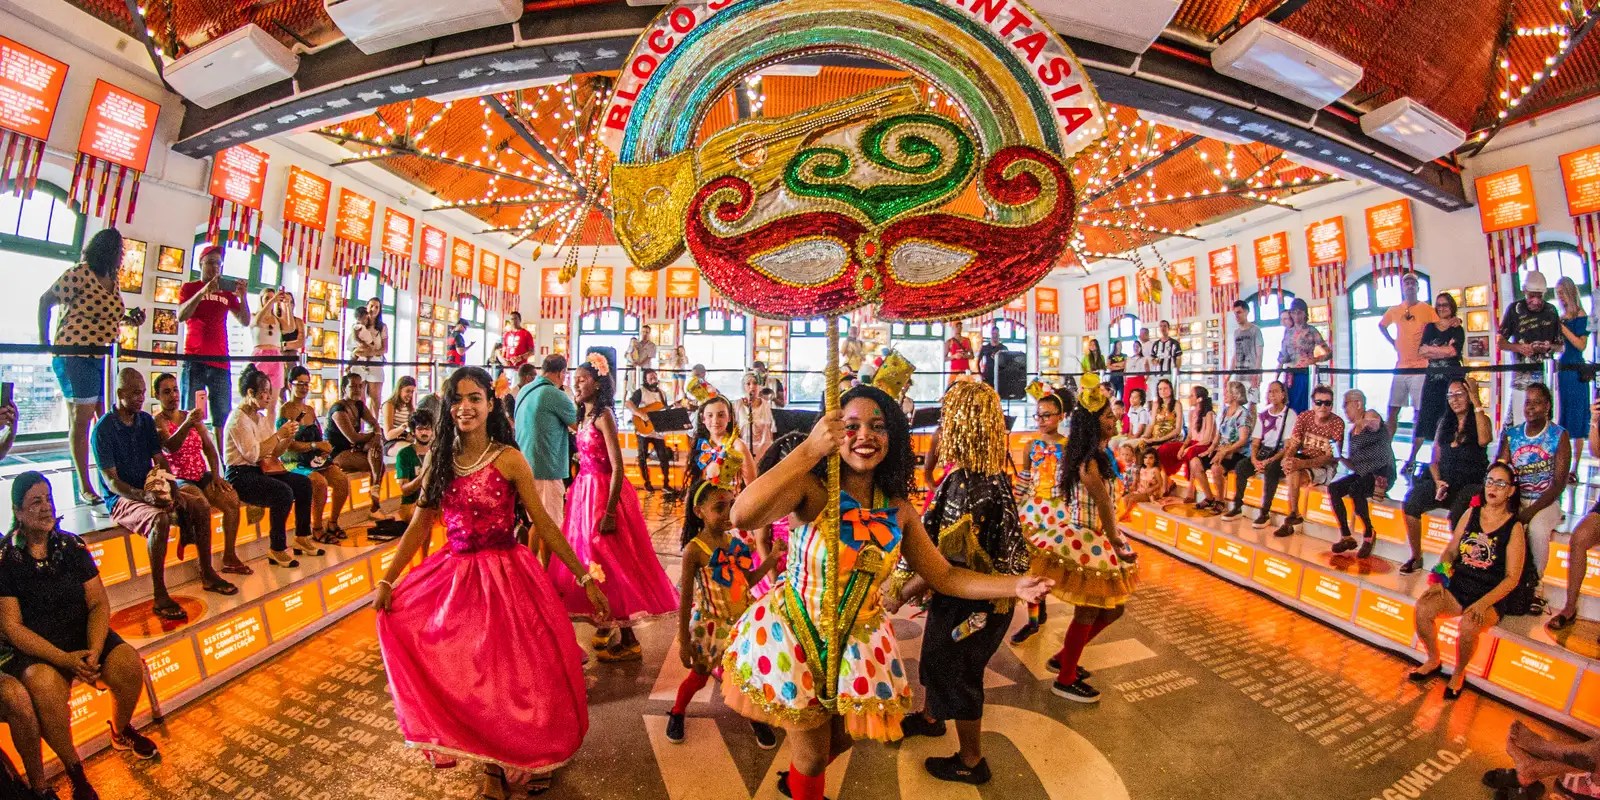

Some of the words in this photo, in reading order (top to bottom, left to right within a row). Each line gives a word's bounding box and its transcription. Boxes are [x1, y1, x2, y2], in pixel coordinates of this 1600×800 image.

[605, 7, 696, 130] BLOCO
[956, 0, 1093, 135] NTASIA
[204, 626, 232, 646] SISTEMA
[214, 635, 256, 660] COMUNICAÇÃO
[204, 646, 214, 656] DO
[318, 681, 342, 694] OU
[342, 688, 378, 706] NÃO
[1112, 670, 1180, 692] VALDEMAR
[1122, 691, 1144, 703] DE
[1143, 677, 1198, 698] OLIVEIRA
[209, 695, 300, 739] SABEDORIA
[282, 687, 316, 702] FOI
[338, 706, 402, 734] ACABO
[1294, 712, 1330, 732] MARCHA
[187, 707, 295, 761] CONVENCERÁ
[282, 706, 330, 729] MELO
[338, 726, 379, 747] COM
[228, 752, 270, 778] NÃO
[202, 766, 242, 793] NEM
